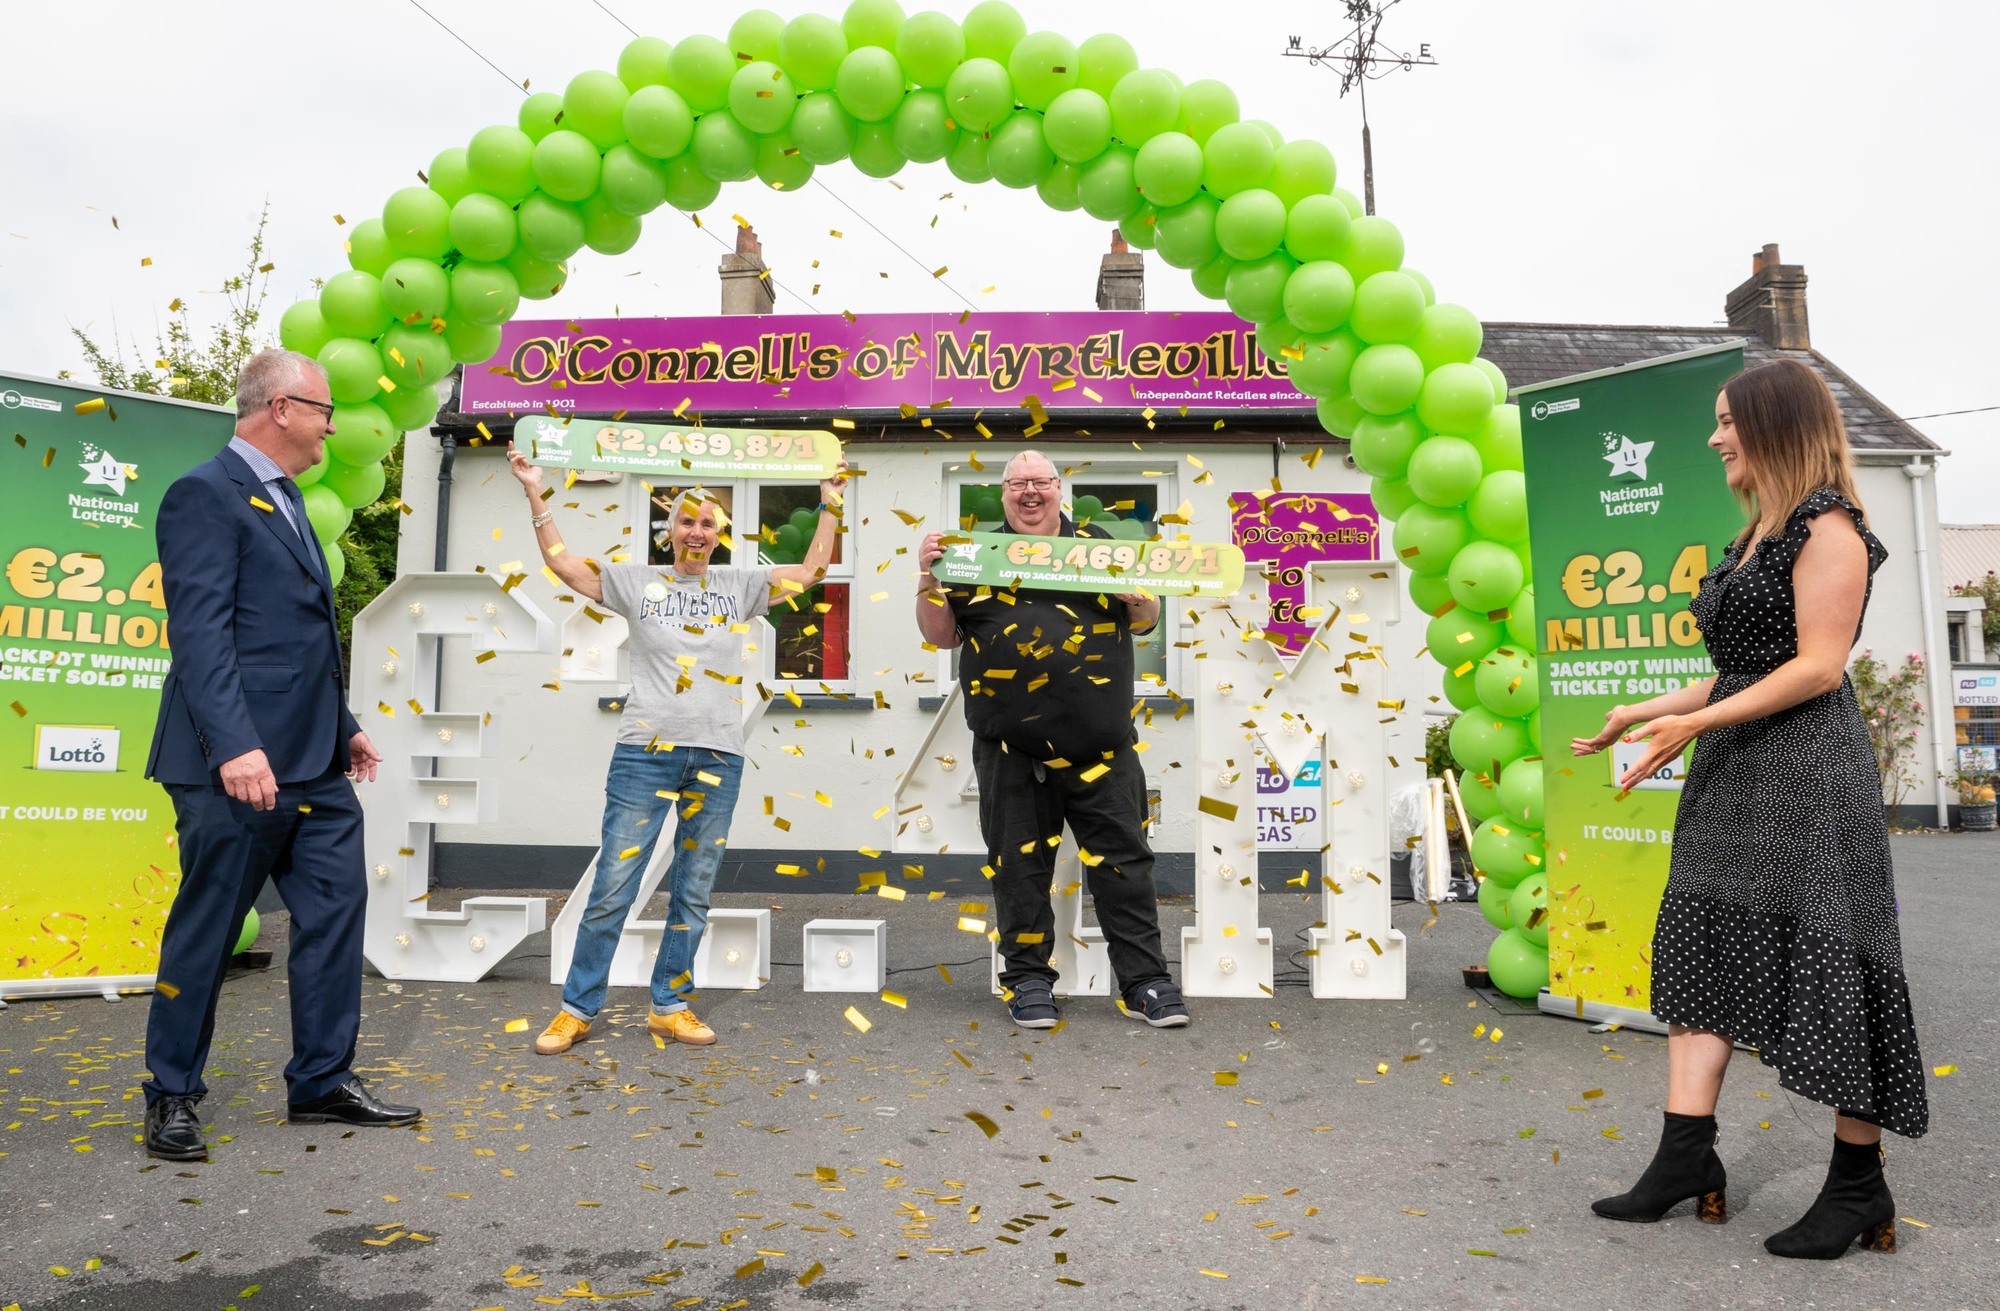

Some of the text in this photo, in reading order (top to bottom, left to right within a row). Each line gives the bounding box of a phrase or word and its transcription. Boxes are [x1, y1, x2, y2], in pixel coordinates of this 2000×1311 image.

[1288, 35, 1301, 49] W
[1420, 43, 1431, 57] E
[510, 333, 842, 385] O'Connell's
[853, 331, 921, 381] of
[532, 400, 543, 409] in
[1269, 391, 1302, 400] since
[595, 425, 817, 462] €2,469,871
[591, 454, 627, 465] LOTTO
[627, 456, 676, 466] JACKPOT
[677, 459, 725, 469] NNING
[1600, 482, 1664, 504] National
[68, 493, 140, 514] National
[1604, 500, 1661, 517] Lottery
[71, 507, 134, 528] Lottery
[1242, 526, 1369, 545] O'Connell's
[945, 561, 983, 572] National
[1006, 540, 1219, 577] €2,469,871
[5, 546, 167, 610] €2.4
[947, 569, 979, 580] Lottery
[999, 569, 1031, 579] LOTTO
[1031, 572, 1078, 582] JACKPOT
[1079, 574, 1126, 585] WINNING
[1127, 577, 1163, 587] TICKET
[1164, 578, 1191, 588] SOLD
[1561, 543, 1709, 609] €2.4
[639, 591, 739, 622] GALVESTON
[1546, 610, 1702, 652] MILLIO
[0, 646, 173, 674] CKPOT WINNIN
[1549, 656, 1720, 678] JACKPOT WINNI
[0, 664, 60, 683] CKET
[65, 668, 127, 687] SOLD
[1550, 679, 1621, 696] TICKET
[1625, 677, 1682, 696] SOLD
[1958, 695, 1998, 703] BOTTLED
[50, 746, 105, 763] Lotto
[14, 806, 78, 821] COULD
[82, 807, 106, 821] BE
[110, 808, 148, 822] YOU
[1257, 806, 1317, 823] TTLED
[1583, 824, 1673, 844] IT COULD B
